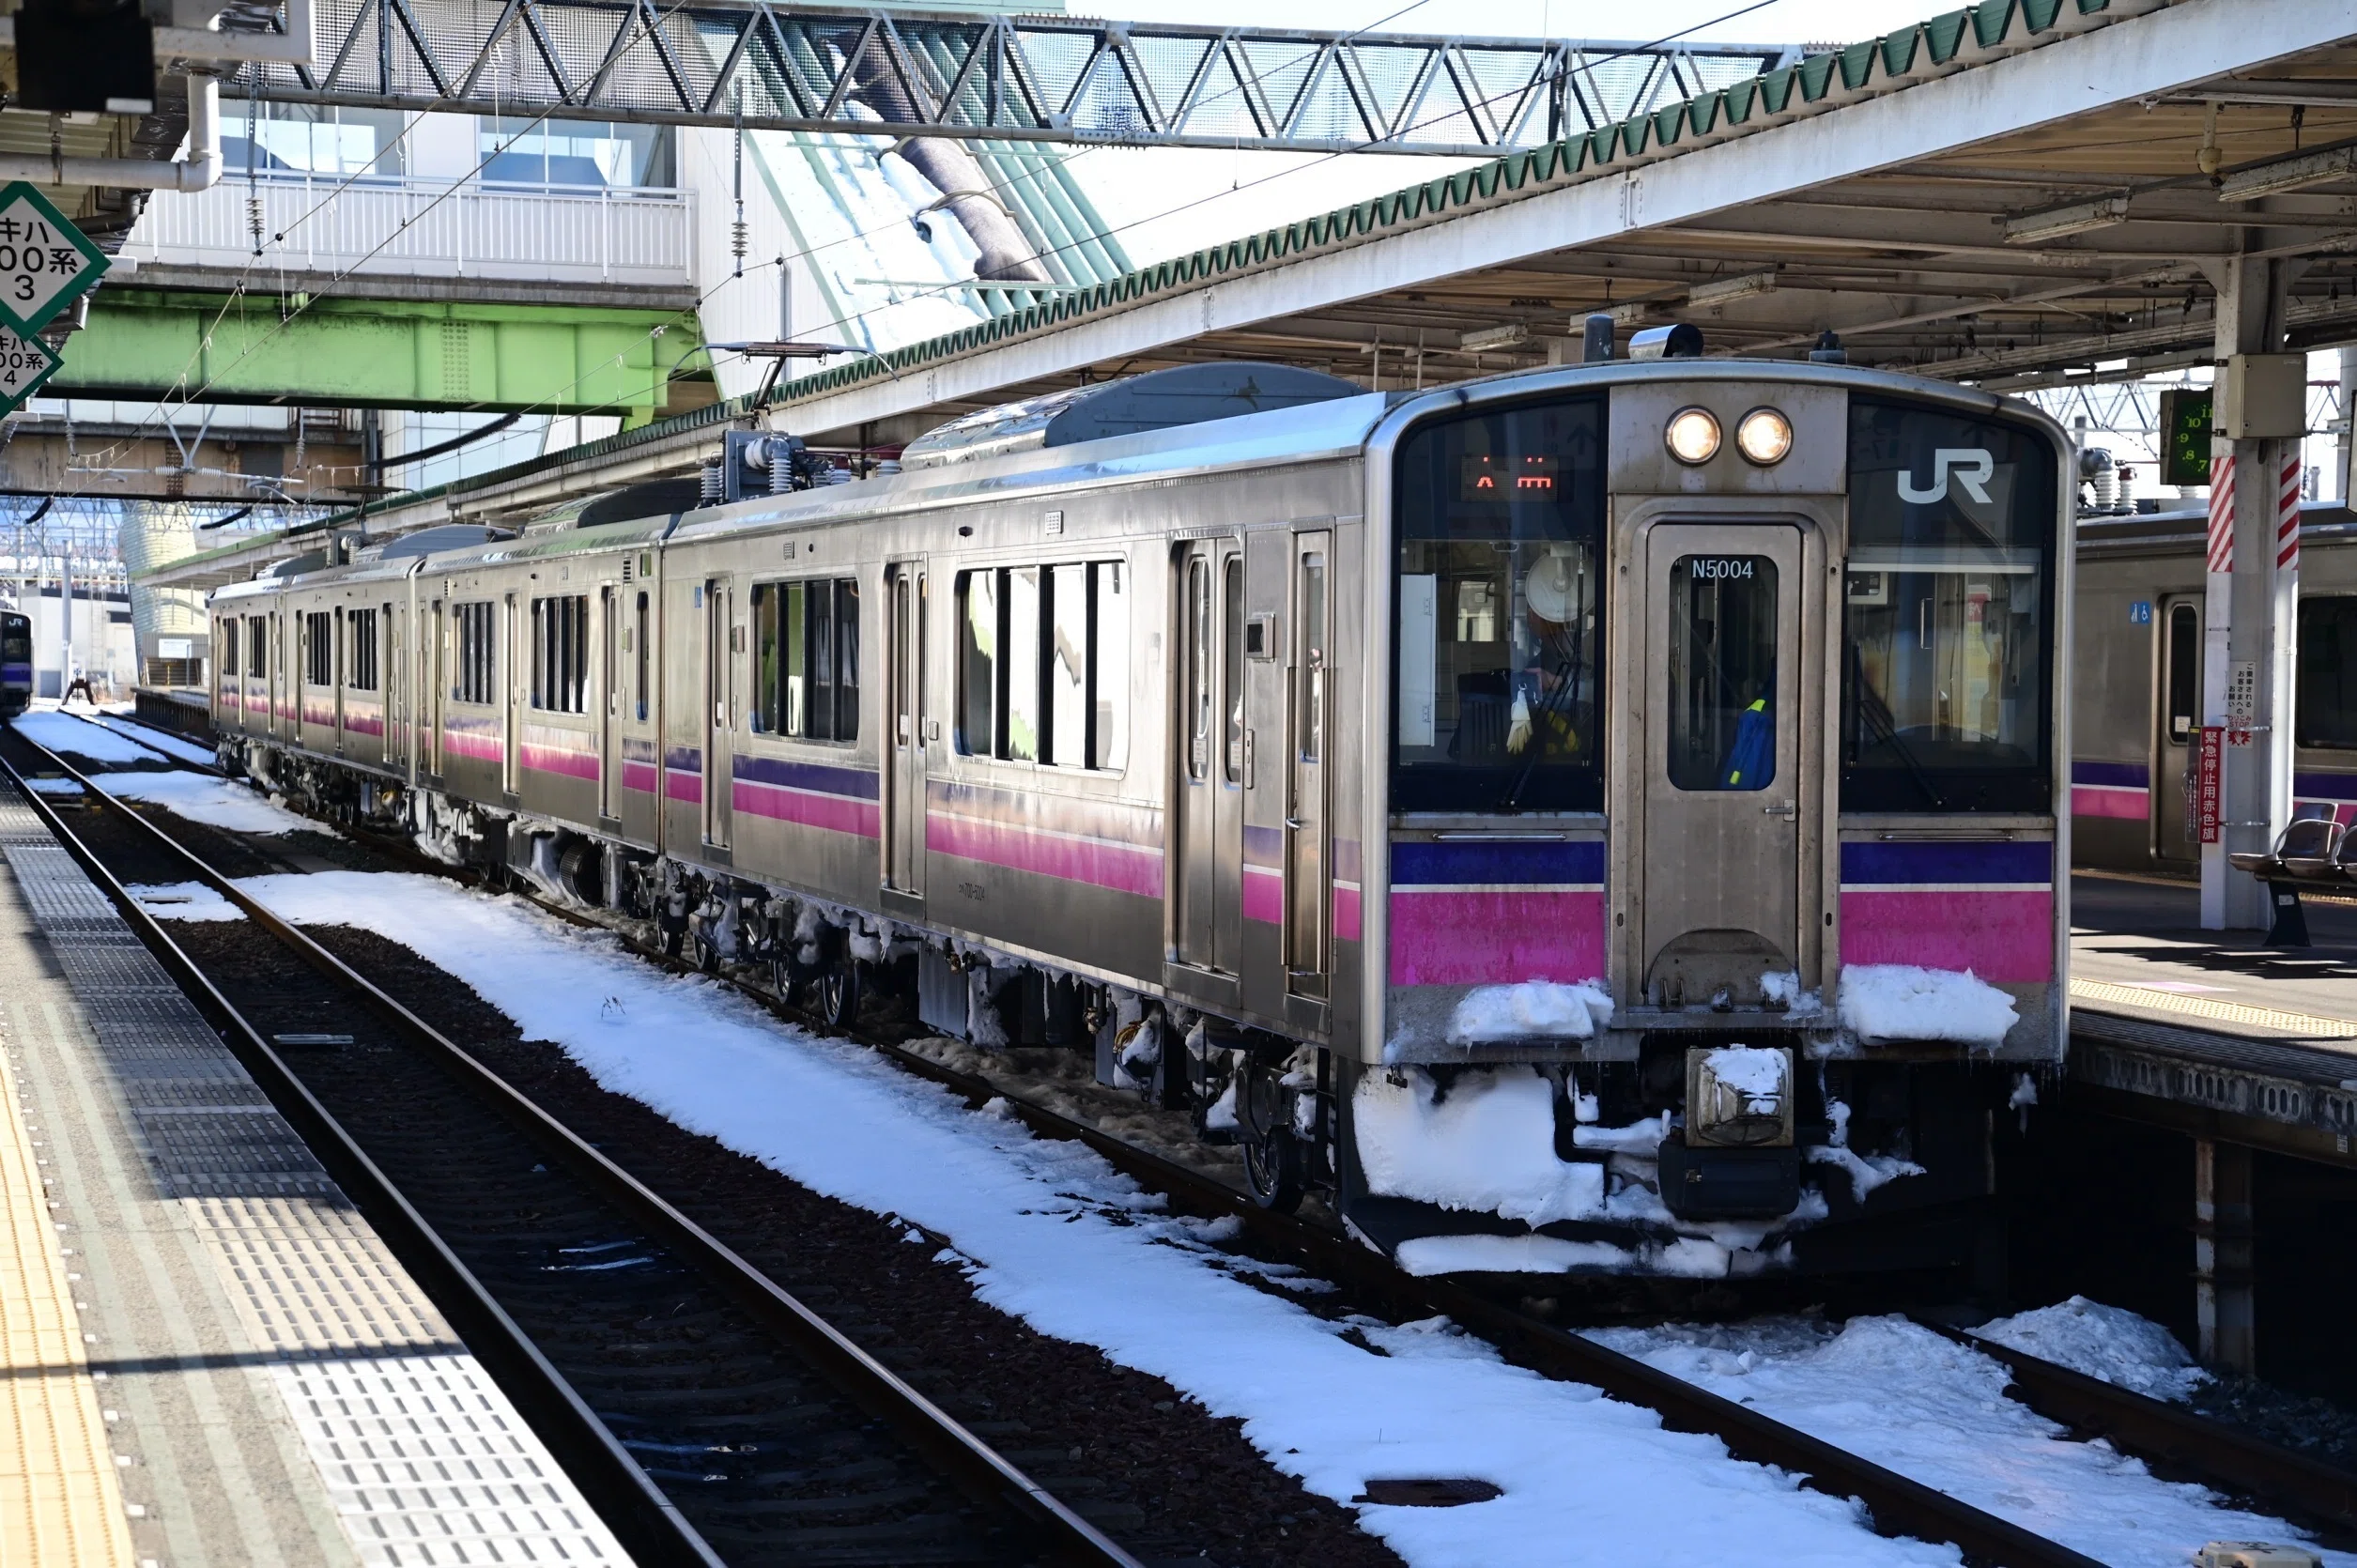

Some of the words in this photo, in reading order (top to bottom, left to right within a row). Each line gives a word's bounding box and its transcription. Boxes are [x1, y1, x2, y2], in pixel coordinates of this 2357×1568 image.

[0, 217, 50, 244] キハ
[15, 274, 35, 300] 3
[4, 370, 17, 386] 4
[2187, 418, 2201, 428] 10
[2180, 433, 2189, 443] 9
[2185, 450, 2195, 460] 8
[2198, 459, 2208, 469] 7
[1897, 448, 1994, 504] JR
[1692, 560, 1753, 578] N5004
[8, 618, 23, 626] JR
[2237, 670, 2245, 715] お客さまへの
[2245, 663, 2254, 708] ご乗車される
[2202, 730, 2217, 840] 緊急停止用赤色旗
